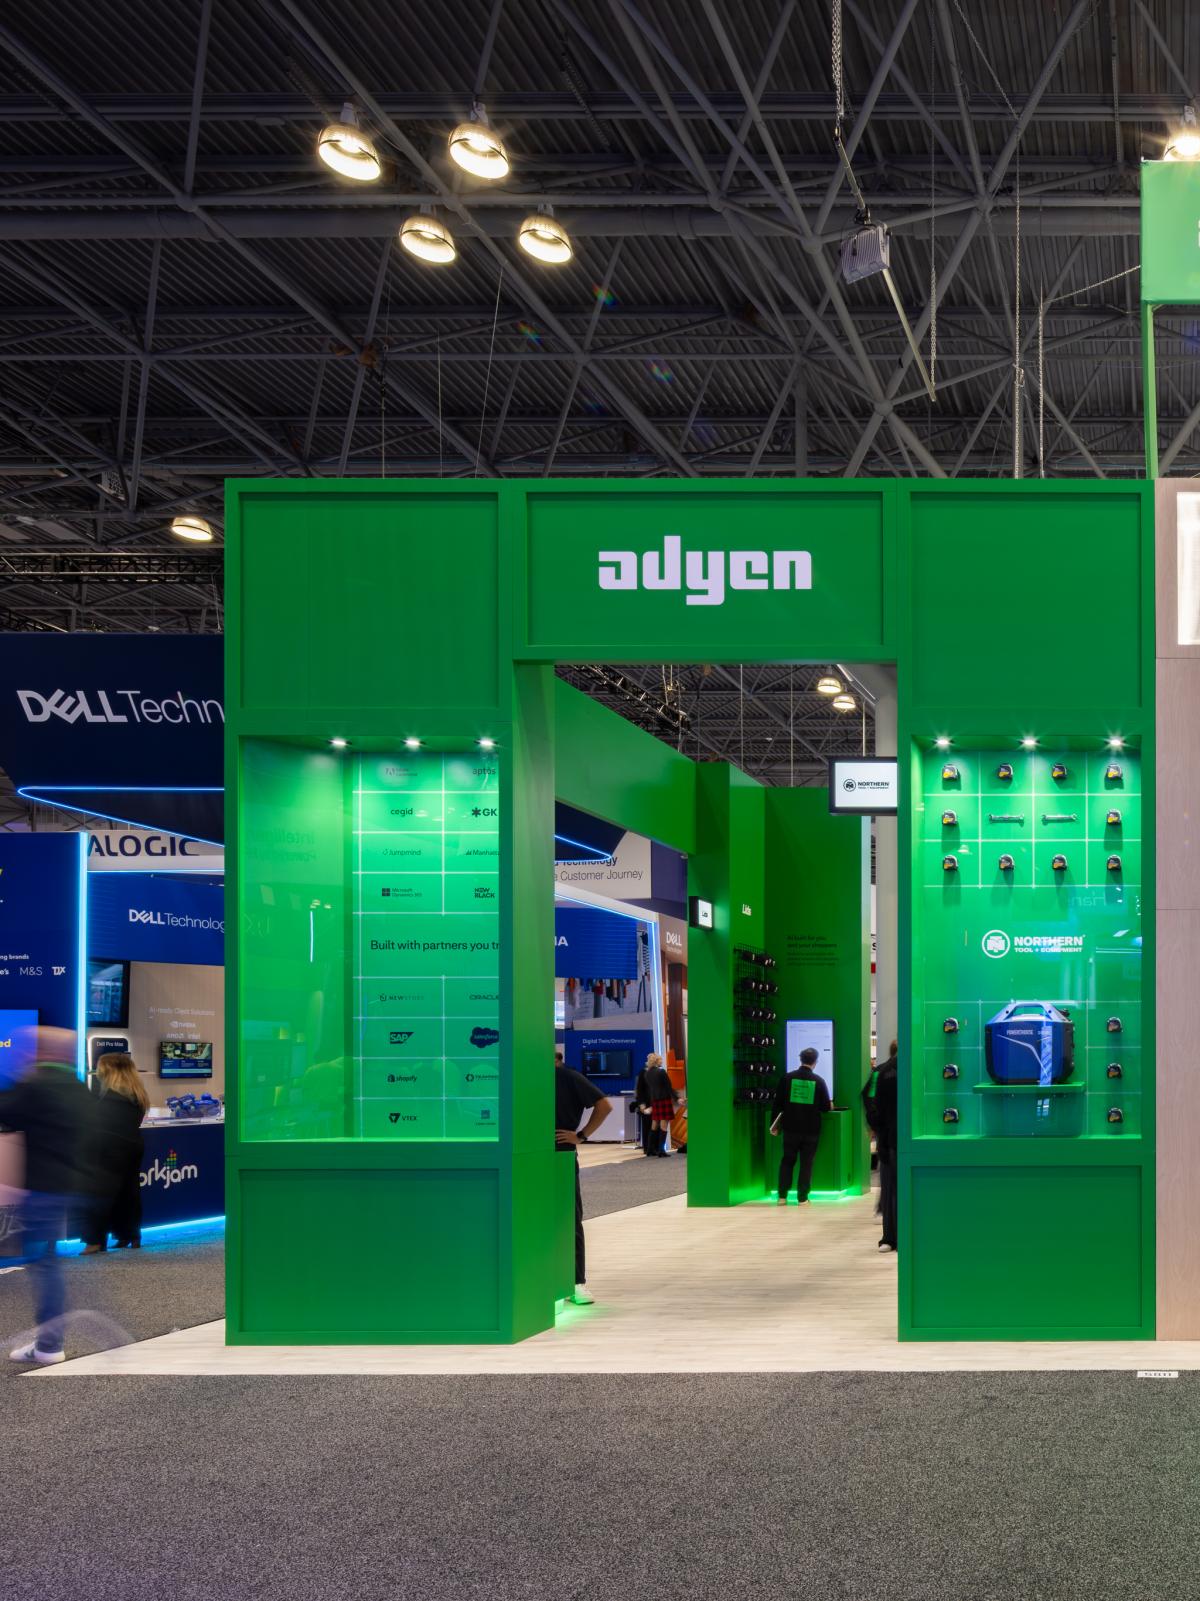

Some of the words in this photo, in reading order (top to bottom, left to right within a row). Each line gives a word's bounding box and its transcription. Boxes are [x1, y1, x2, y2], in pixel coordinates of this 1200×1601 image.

[598, 535, 812, 605] adyen
[17, 688, 128, 724] DELL
[390, 808, 413, 817] cegid
[482, 808, 498, 817] GK
[560, 871, 604, 881] Customer
[606, 869, 643, 880] Journey
[128, 909, 165, 925] DELL
[370, 940, 395, 950] Built
[397, 940, 420, 950] with
[422, 941, 468, 952] partners
[471, 942, 490, 952] you
[1014, 936, 1083, 946] NORTHERN
[19, 967, 43, 976] M&S
